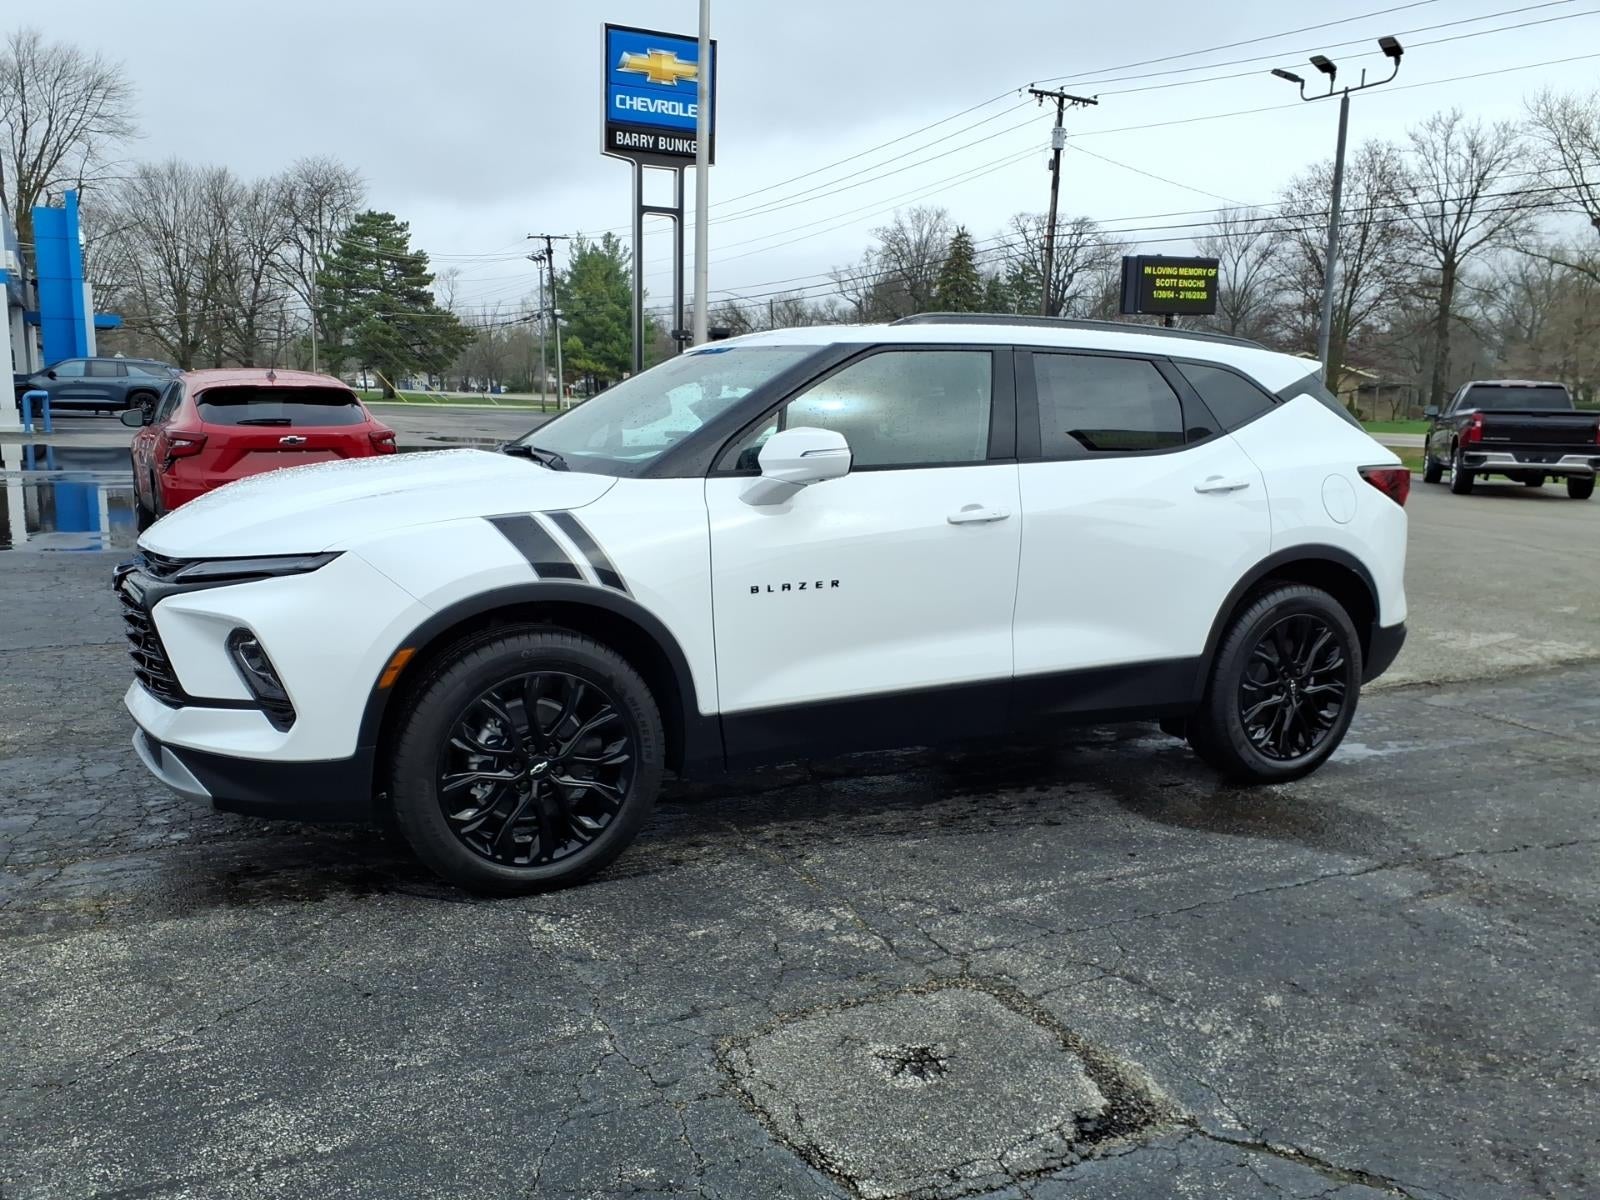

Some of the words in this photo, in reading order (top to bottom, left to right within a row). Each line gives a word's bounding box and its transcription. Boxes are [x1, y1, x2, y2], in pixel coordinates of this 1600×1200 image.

[615, 94, 698, 118] CHEVROLE
[616, 131, 655, 149] BARRY
[658, 136, 697, 153] BUNKE
[1153, 266, 1178, 275] LOVING
[1179, 267, 1207, 276] MEMORY
[750, 579, 840, 594] BLAZER
